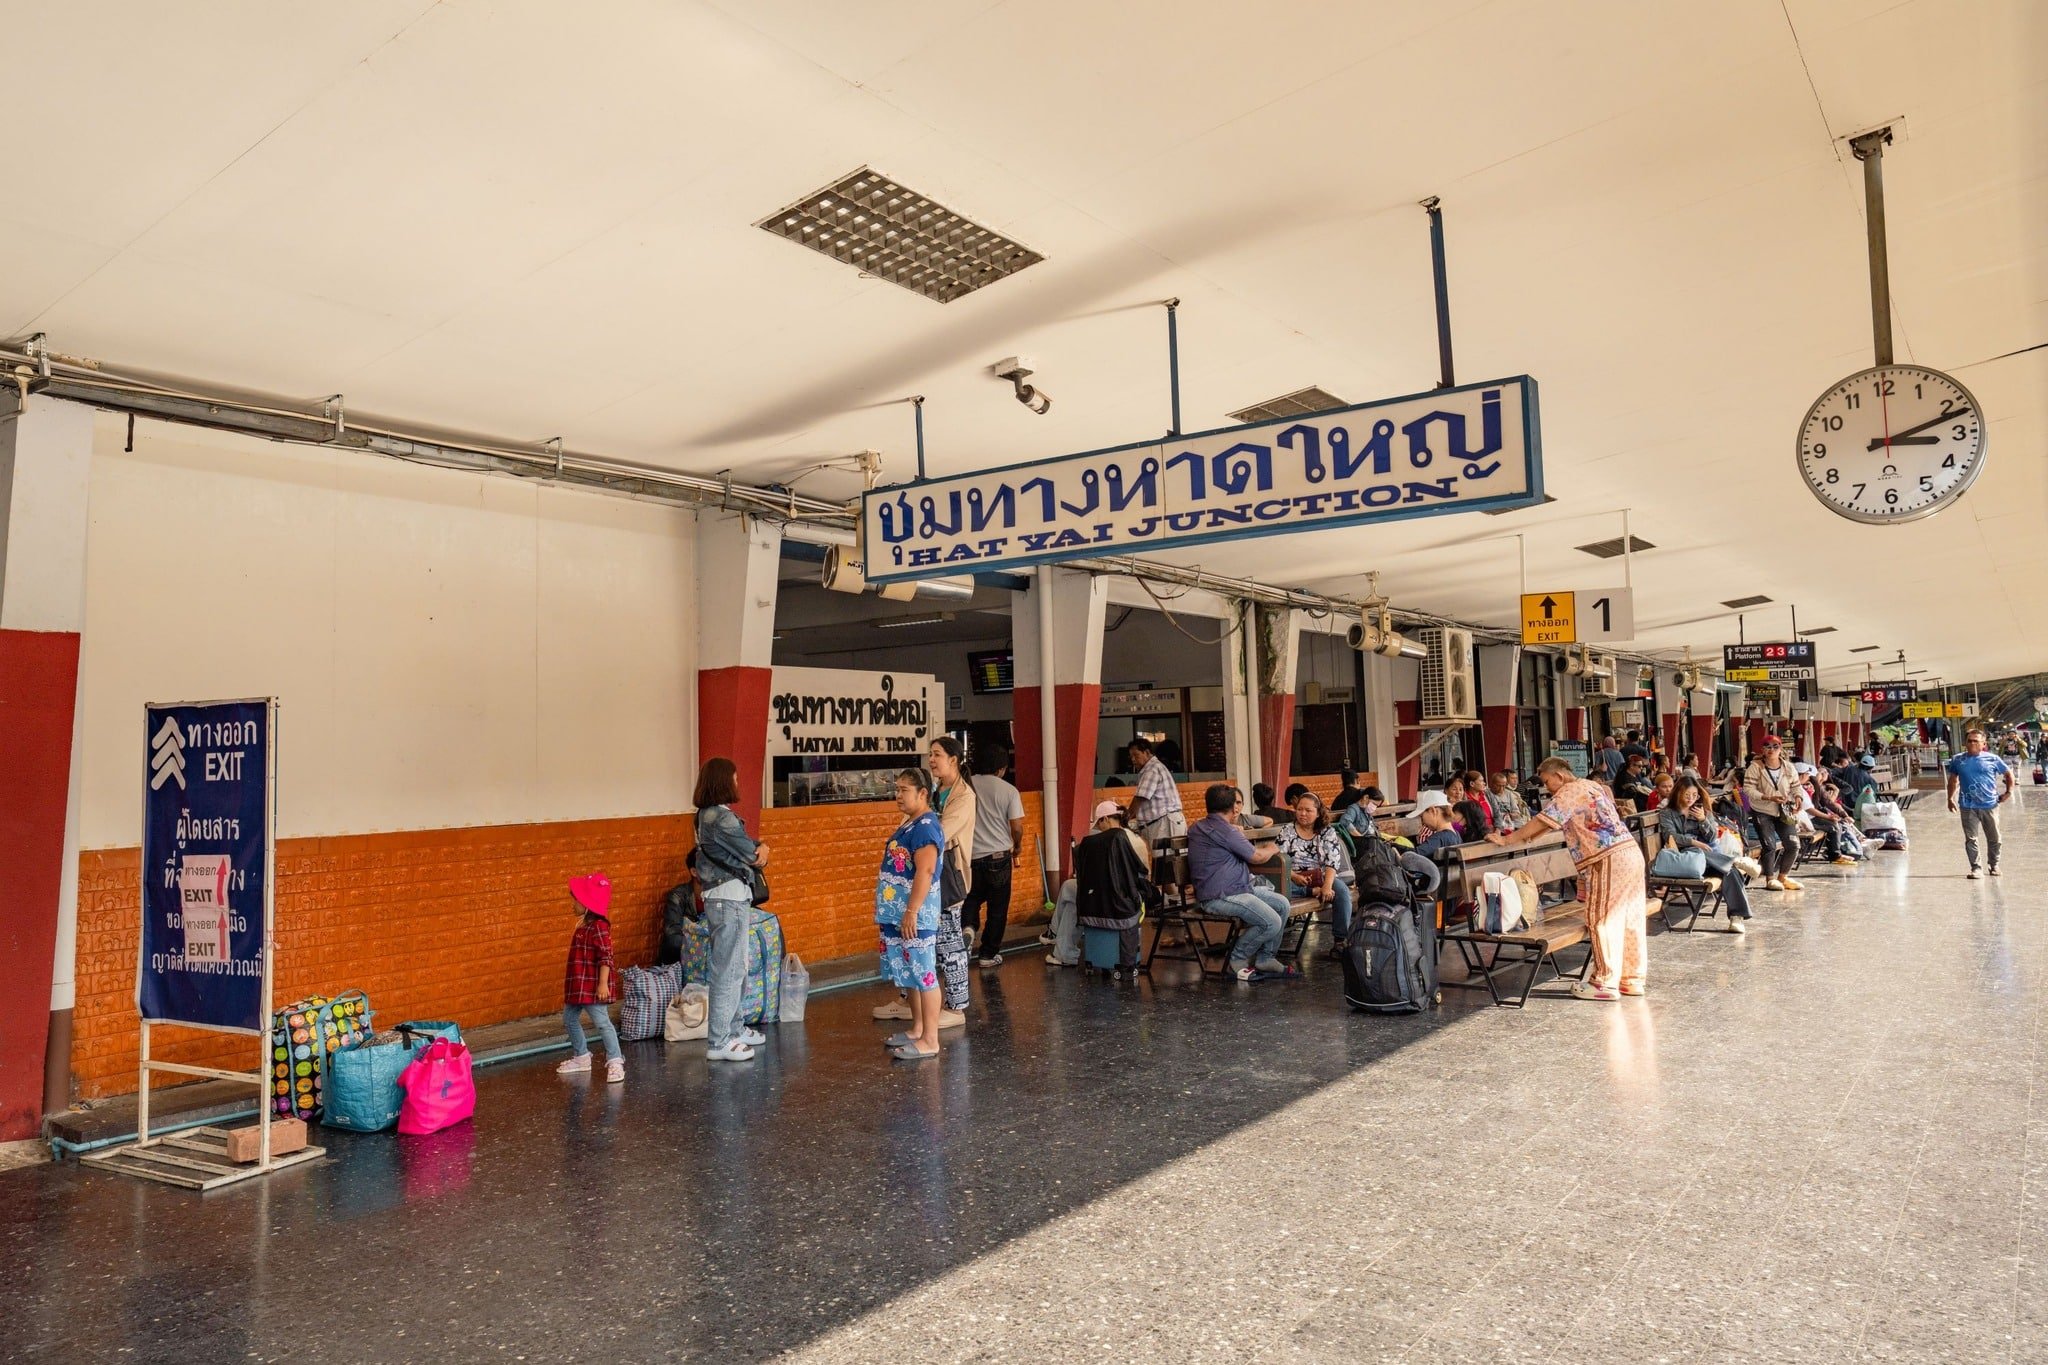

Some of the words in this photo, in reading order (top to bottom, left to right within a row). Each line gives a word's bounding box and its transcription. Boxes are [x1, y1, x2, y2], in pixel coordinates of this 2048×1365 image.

[1873, 380, 1895, 397] 12
[1914, 384, 1922, 399] 1
[1845, 393, 1860, 409] 11
[1822, 415, 1843, 432] 10
[1952, 425, 1966, 441] 3
[1813, 443, 1826, 458] 9
[1942, 454, 1955, 469] 4
[879, 389, 1503, 566] ชุมทางหาดใหญ่
[1826, 468, 1839, 484] 8
[1919, 475, 1933, 492] 5
[1852, 483, 1866, 500] 7
[1884, 489, 1898, 504] 6
[908, 537, 1007, 567] HAT
[1018, 523, 1113, 552] YAI
[1128, 476, 1459, 537] JUNCTION
[1528, 618, 1569, 628] ทางออก
[1592, 598, 1611, 632] 1
[1537, 632, 1560, 641] EXIT
[1766, 647, 1775, 657] 2
[1777, 647, 1785, 656] 3
[1788, 646, 1797, 656] 4
[1799, 645, 1808, 655] 5
[1863, 692, 1873, 701] 2
[1875, 691, 1884, 700] 3
[1887, 690, 1896, 700] 4
[1899, 690, 1908, 700] 5
[773, 675, 928, 740] ชุมทางหาดใหญ่
[1967, 706, 1974, 715] 1
[187, 720, 257, 748] ทางออก
[851, 736, 917, 752] JUNTION
[205, 751, 245, 781] EXIT
[176, 807, 240, 849] ผู้โดยสาร
[184, 889, 213, 902] EXIT
[188, 943, 216, 956] EXIT
